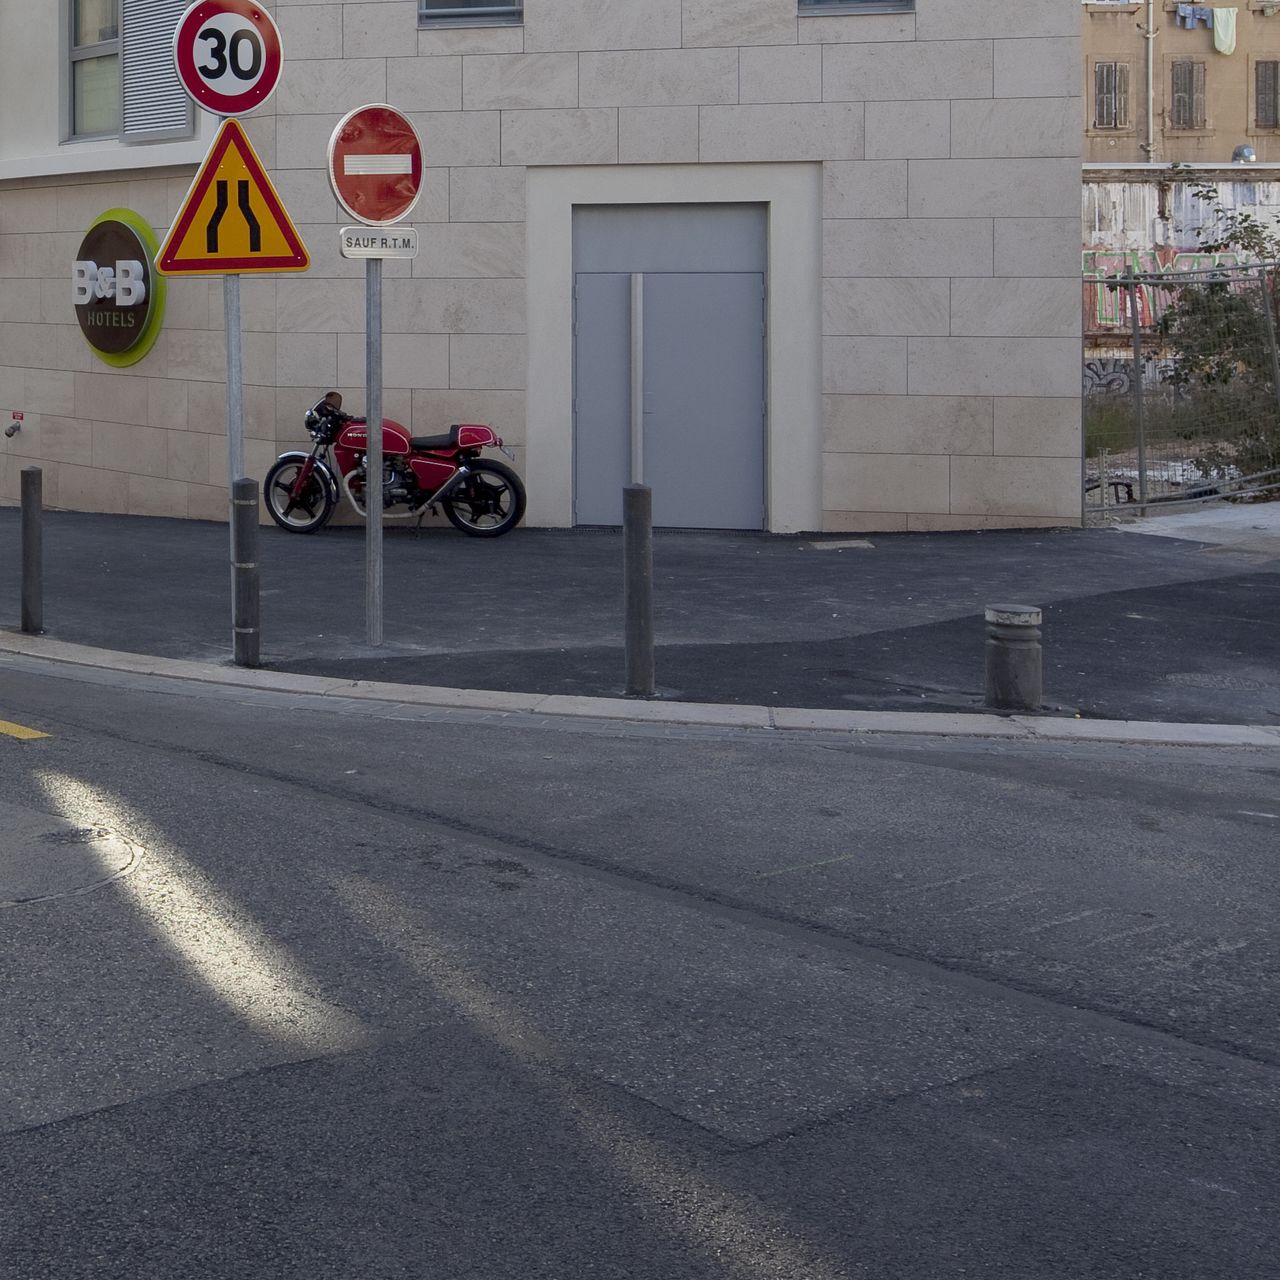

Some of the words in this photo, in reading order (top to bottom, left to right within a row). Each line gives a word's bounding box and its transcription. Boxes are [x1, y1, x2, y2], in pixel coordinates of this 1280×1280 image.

[198, 28, 262, 80] 30
[346, 237, 377, 248] SAUF
[381, 238, 414, 249] R.T.M.
[72, 260, 145, 307] B&B
[87, 311, 135, 327] HOTELS
